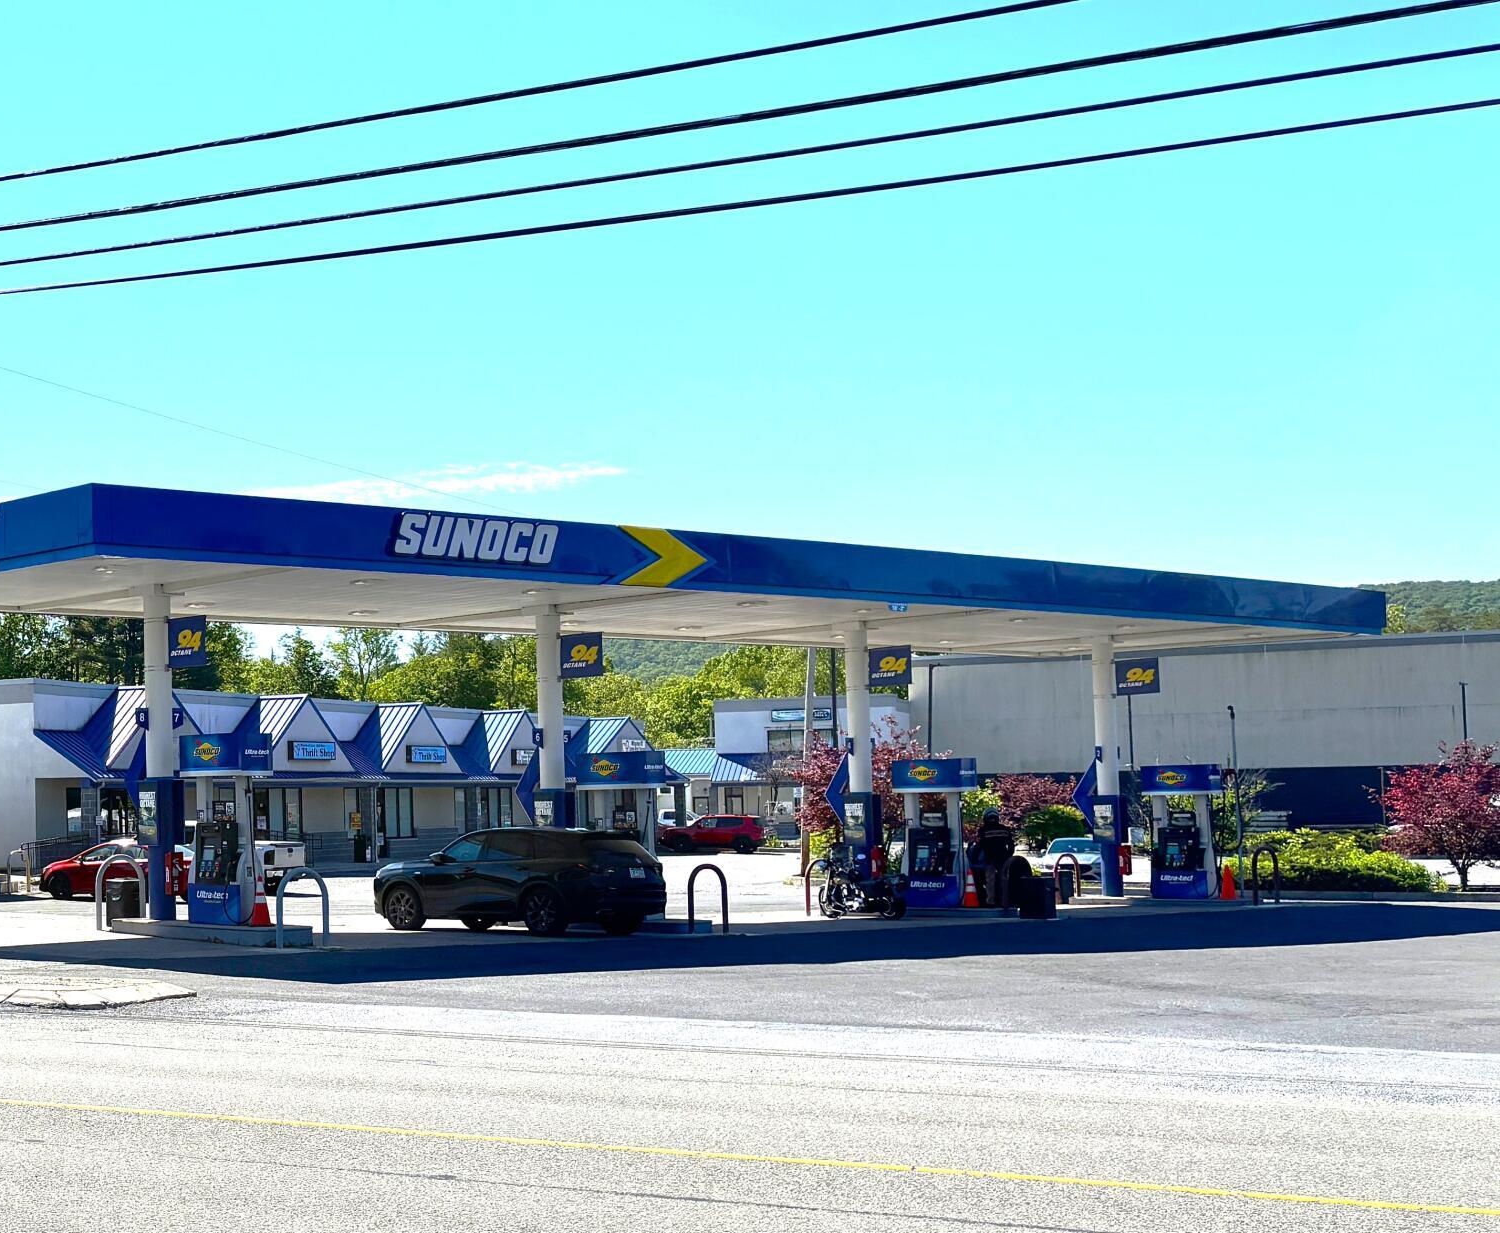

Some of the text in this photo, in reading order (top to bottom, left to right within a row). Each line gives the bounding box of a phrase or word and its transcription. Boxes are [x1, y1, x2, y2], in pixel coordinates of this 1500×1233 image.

[394, 513, 560, 564] SUNOCO
[177, 629, 202, 652] 94
[170, 648, 192, 656] OCTANE
[570, 644, 599, 664] 94
[879, 656, 908, 674] 94
[871, 671, 896, 679] OCTANE
[1126, 667, 1155, 684] 94
[139, 712, 145, 722] 8
[173, 713, 180, 723] 7
[535, 732, 541, 742] 6
[563, 734, 569, 743] 5
[194, 747, 220, 757] SUNOCO
[301, 747, 335, 759] Thrift Shop
[418, 751, 432, 760] Thrift
[591, 763, 619, 772] SUNOCO
[908, 769, 937, 777] SUNOCO
